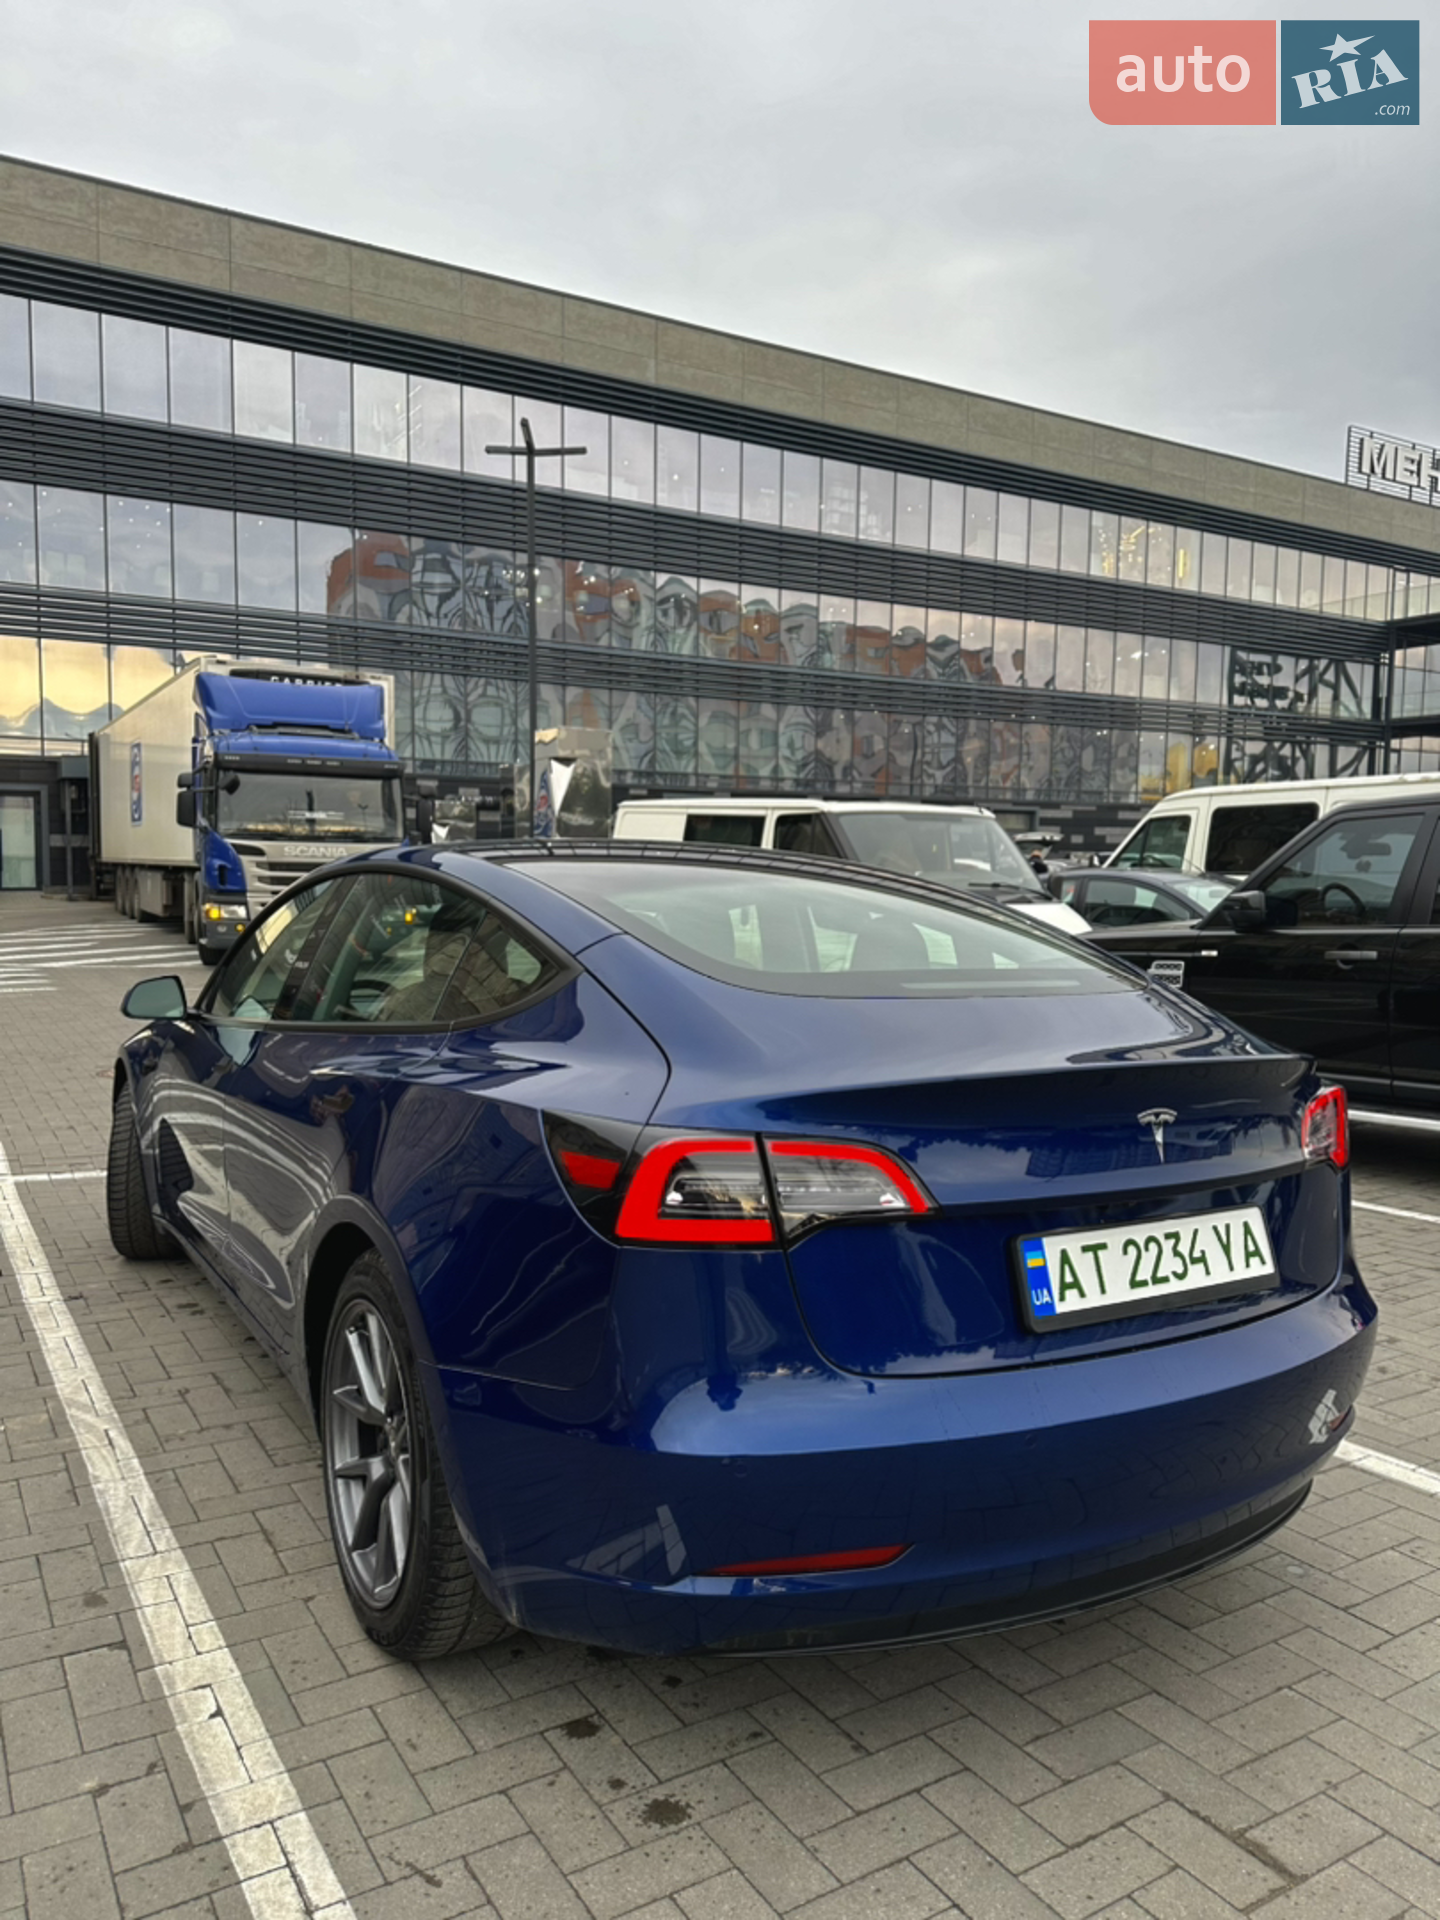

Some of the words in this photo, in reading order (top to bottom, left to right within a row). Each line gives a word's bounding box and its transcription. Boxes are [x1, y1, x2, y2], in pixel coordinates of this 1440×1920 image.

[270, 675, 343, 687] CARRI
[284, 845, 348, 858] SCANIA
[1058, 1242, 1109, 1302] AT
[1122, 1227, 1212, 1290] 2234
[1212, 1220, 1267, 1273] YA
[1031, 1288, 1052, 1306] UA
